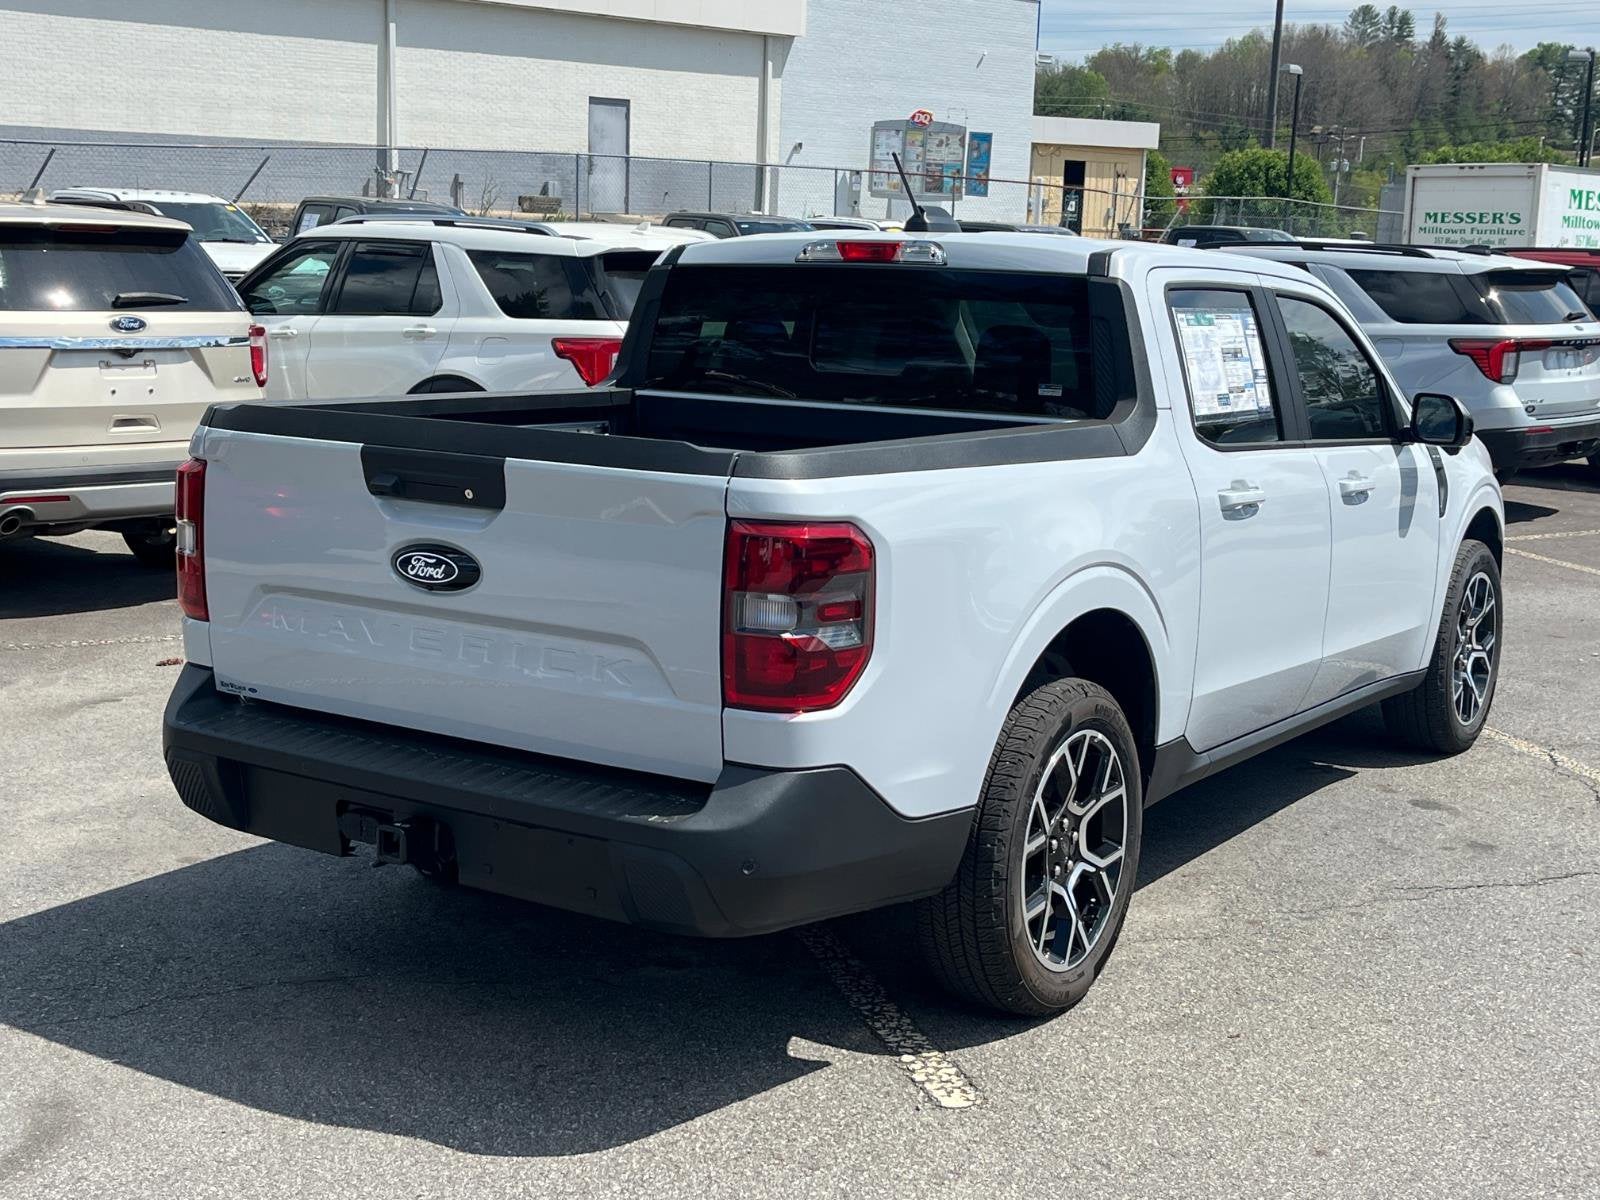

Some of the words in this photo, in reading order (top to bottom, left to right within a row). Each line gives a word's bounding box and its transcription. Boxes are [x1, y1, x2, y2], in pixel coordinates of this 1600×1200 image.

[914, 113, 931, 124] DQ
[1424, 211, 1522, 225] MESSER'S
[1418, 226, 1466, 235] Milltown
[1470, 227, 1526, 236] Furniture
[119, 318, 140, 328] Ford
[408, 556, 446, 579] Ford
[265, 605, 633, 688] MAVERICK
